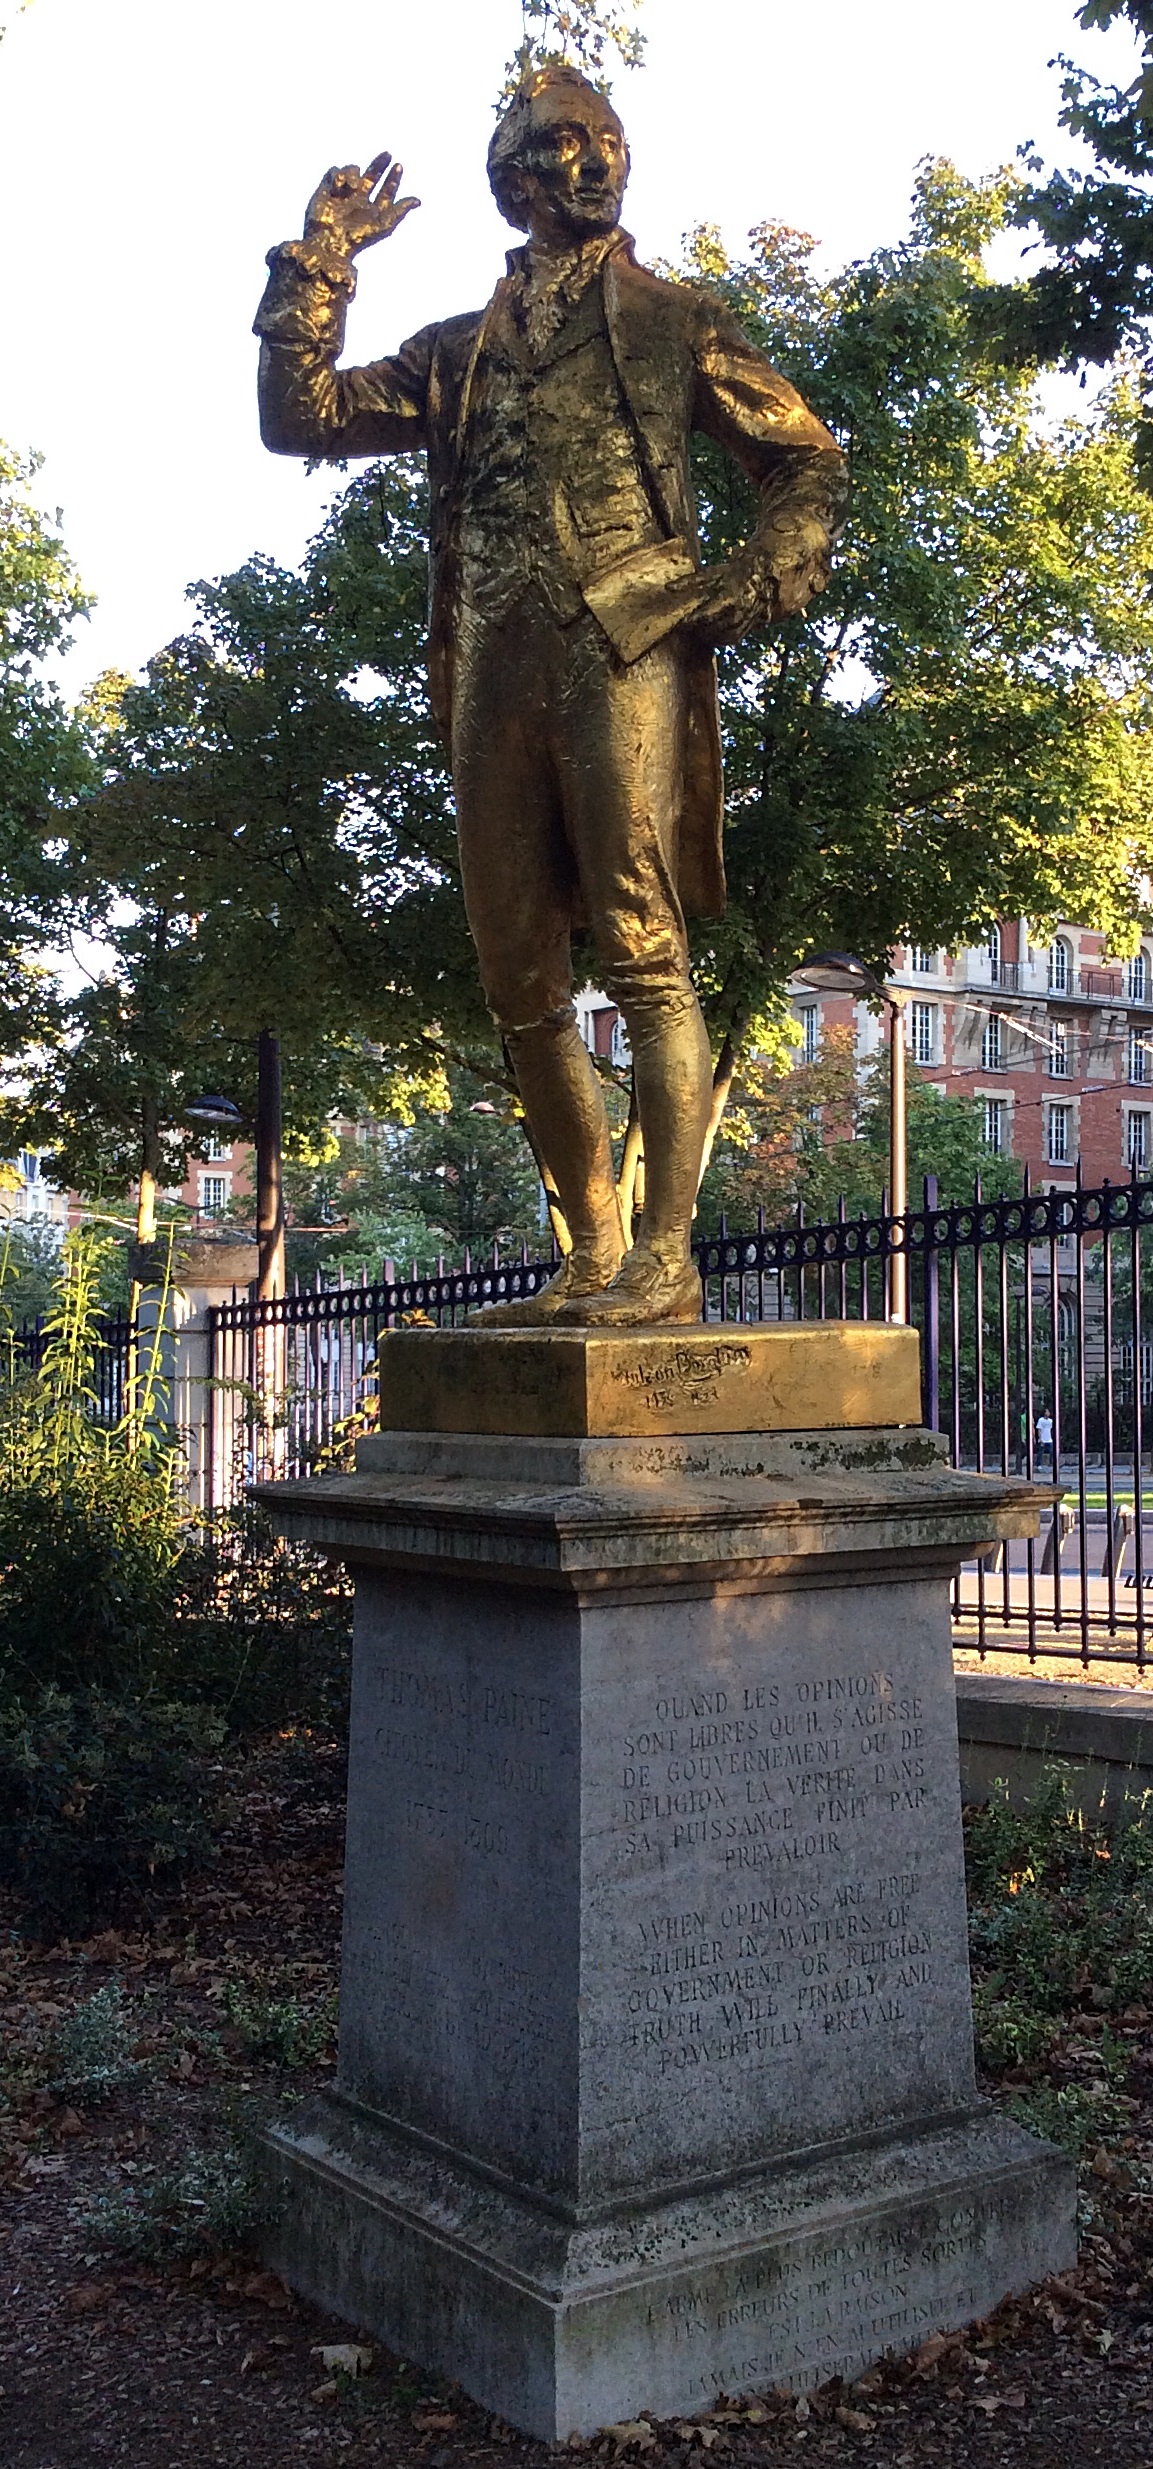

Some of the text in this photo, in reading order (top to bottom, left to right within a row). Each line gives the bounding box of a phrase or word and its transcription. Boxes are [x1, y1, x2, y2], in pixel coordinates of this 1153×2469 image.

[655, 1671, 894, 1722] QUAND LES OPINIONS
[621, 1727, 925, 1791] DE GOUVERNEMENT OU DE
[622, 1728, 679, 1758] SONT
[688, 1718, 759, 1750] LIBRES
[622, 1785, 727, 1824] RELIGION
[745, 1779, 774, 1804] LA
[874, 1757, 926, 1785] DANS
[624, 1786, 928, 1856] SA PUISSANCE FINIT PAR
[722, 1830, 842, 1873] PREVALOIR
[637, 1872, 921, 1945] WHEN OPINIONS ARE FREE
[648, 1903, 911, 1978] EITHER IN MATTERS OF
[625, 1961, 933, 2049] TRUTH WILL FINALLY AND
[626, 1929, 933, 2015] GOVERNMENT OR RELIGION
[658, 1999, 906, 2075] POWERFULLY PREVAIL
[807, 2277, 832, 2300] DE
